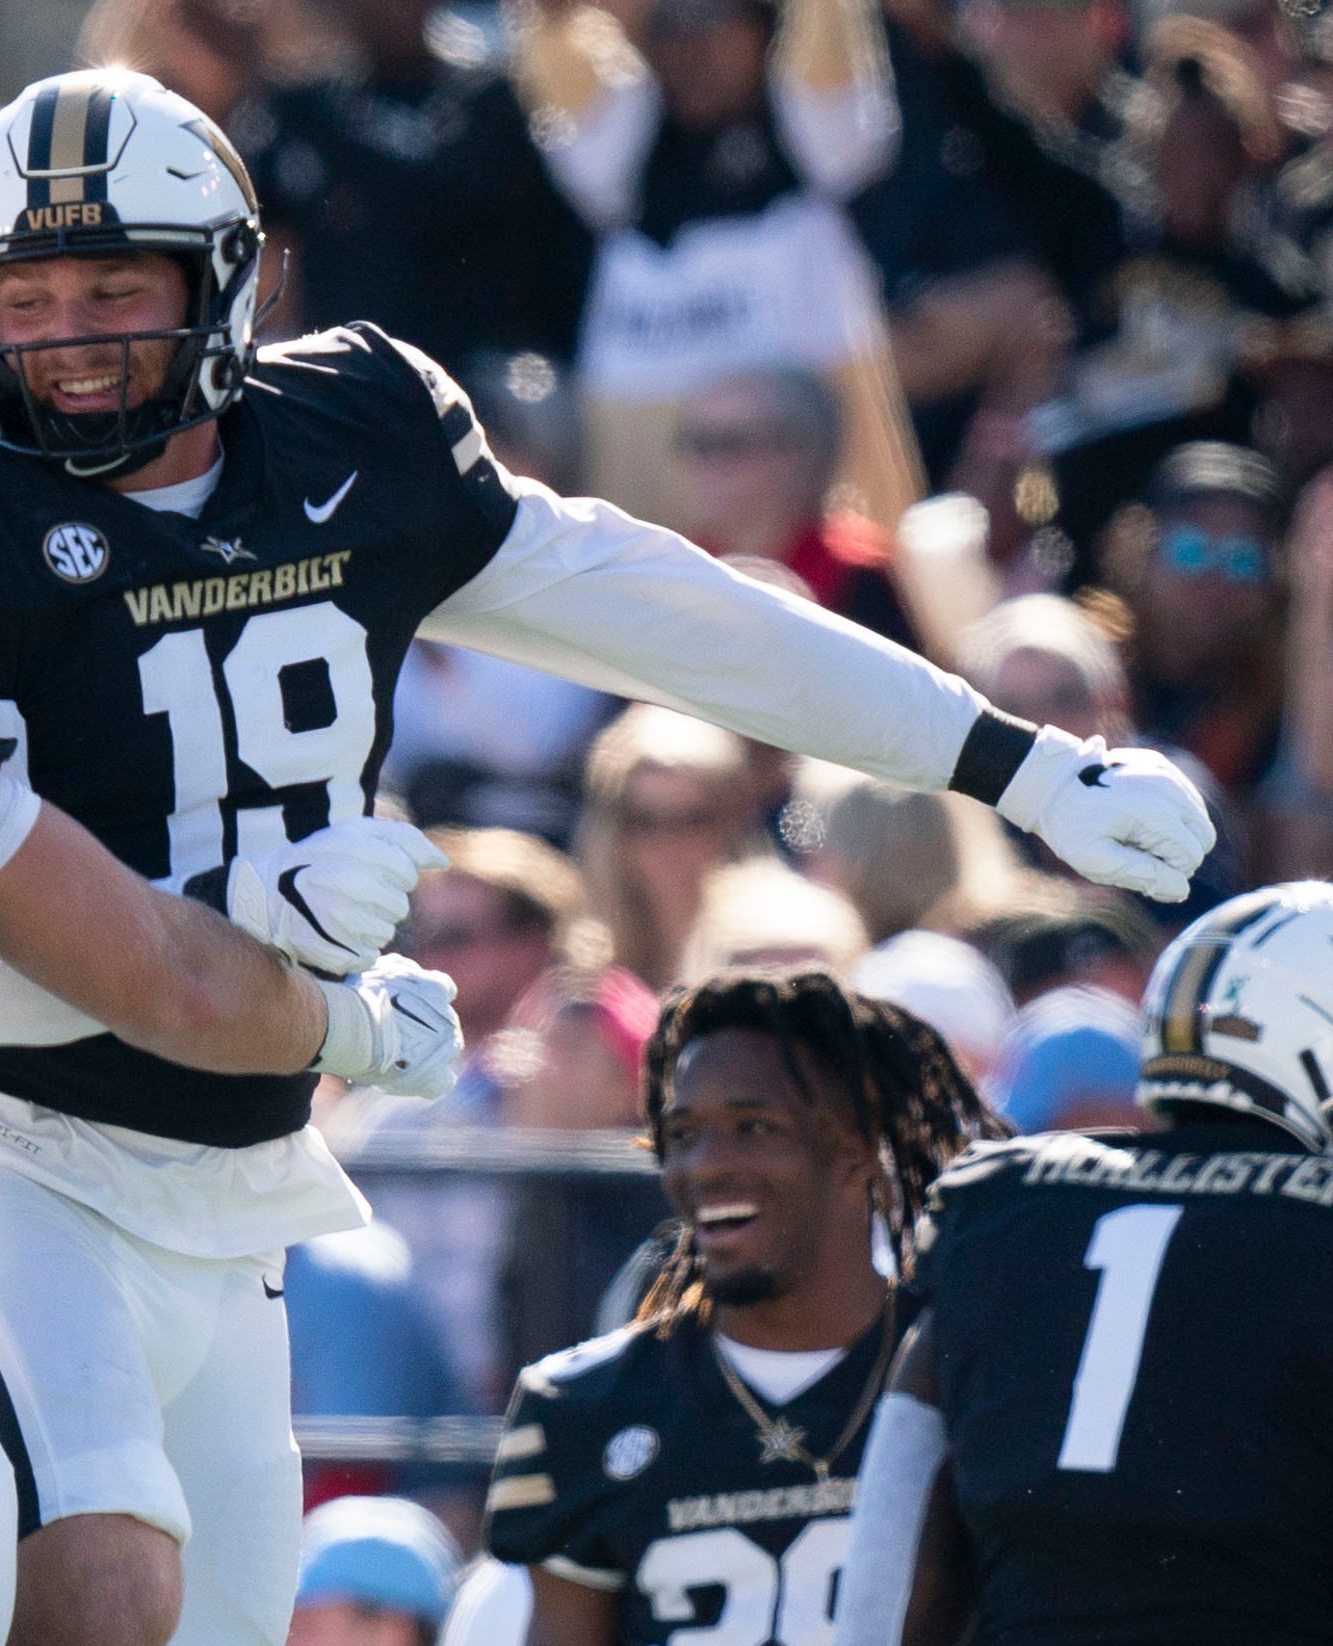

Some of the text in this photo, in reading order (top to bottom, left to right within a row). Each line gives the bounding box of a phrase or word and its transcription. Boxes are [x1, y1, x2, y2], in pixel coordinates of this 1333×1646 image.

[26, 203, 102, 231] VUFB
[47, 523, 105, 580] SEC
[124, 550, 351, 627] VANDERBILT
[137, 601, 376, 893] 19
[1057, 1203, 1185, 1473] 1
